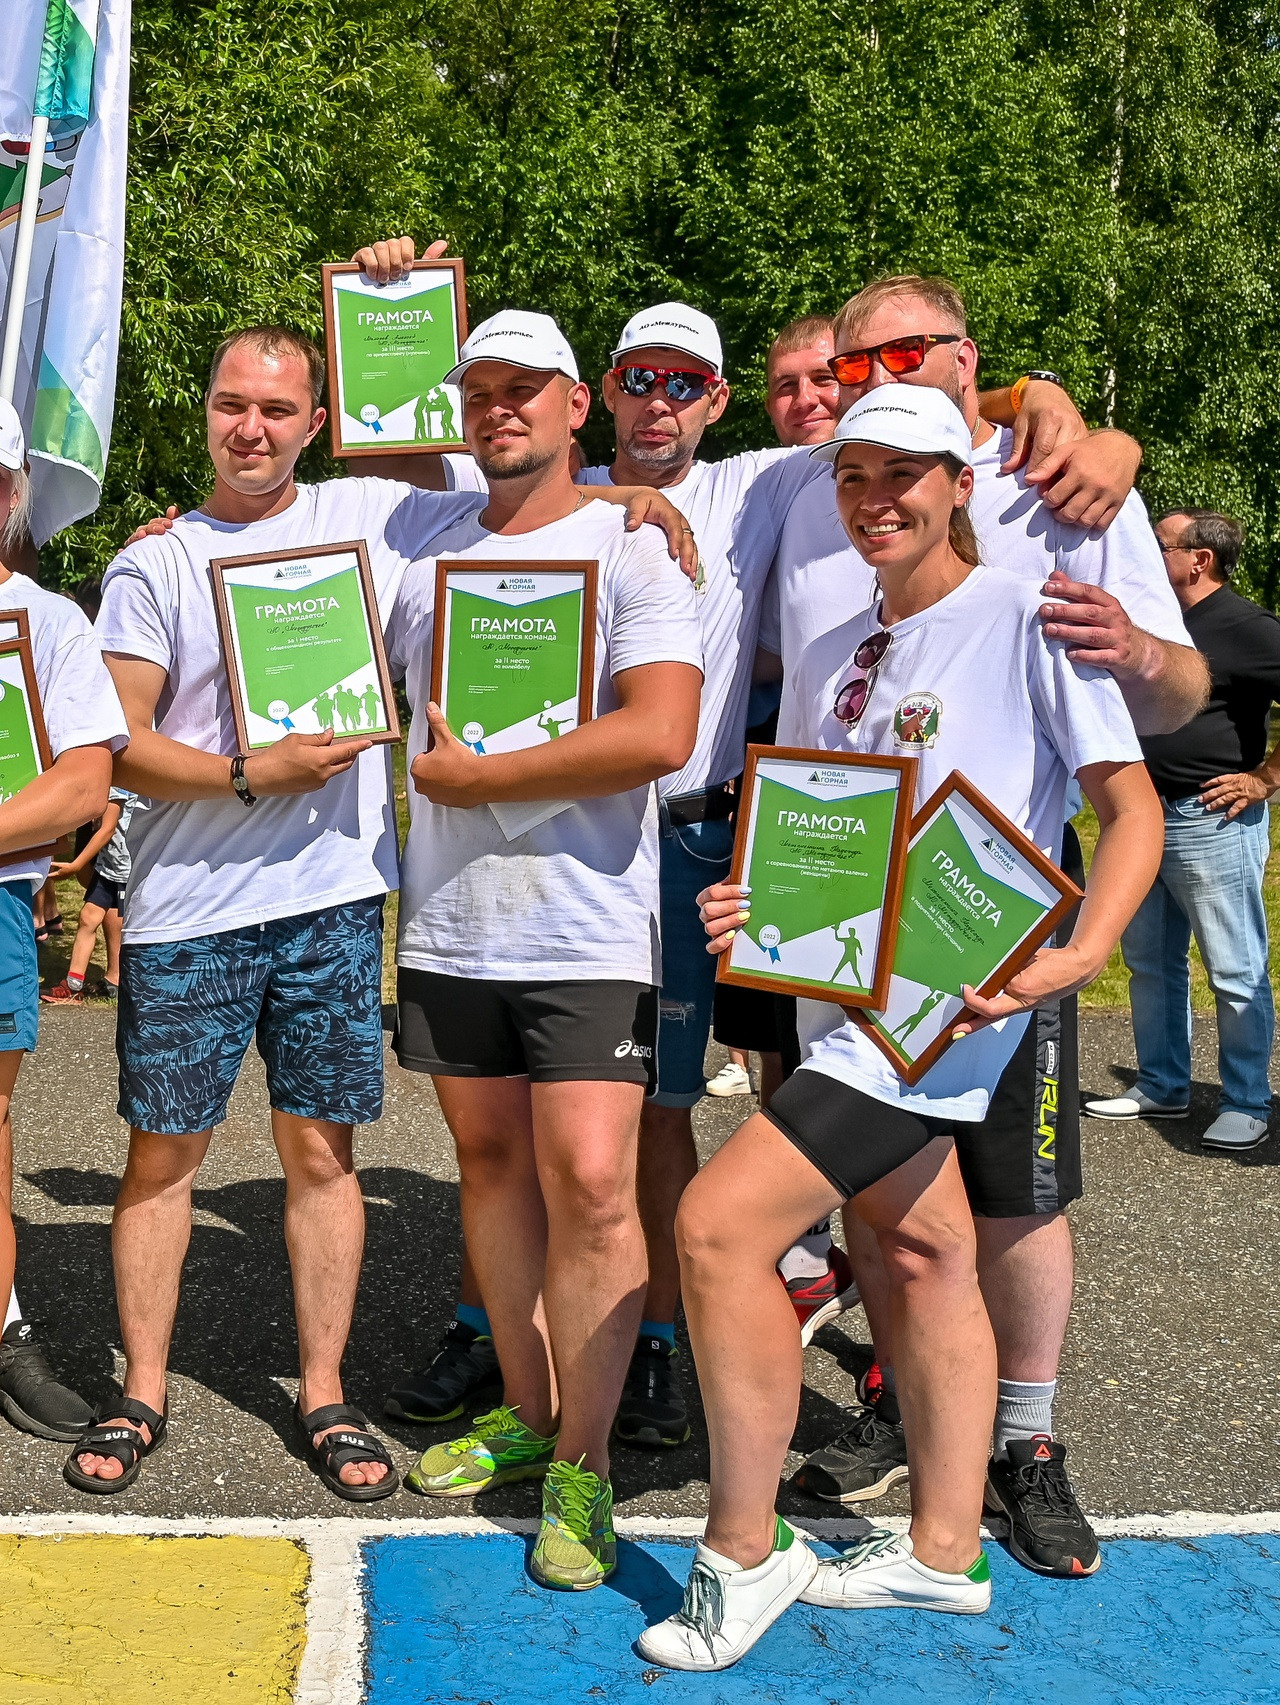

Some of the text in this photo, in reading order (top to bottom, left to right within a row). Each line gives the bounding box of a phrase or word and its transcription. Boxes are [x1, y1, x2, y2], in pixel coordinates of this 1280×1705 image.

[358, 310, 434, 326] ГРАМОТА
[255, 596, 340, 620] ГРАМОТА
[274, 612, 325, 624] награждается
[471, 618, 557, 633] ГРАМОТА
[778, 810, 866, 834] ГРАМОТА
[794, 830, 848, 840] награждается
[990, 848, 1014, 872] ГОРНАЯ
[996, 842, 1016, 864] НОВАЯ
[932, 850, 1002, 928] ГРАМОТА
[938, 876, 980, 920] награждается
[928, 906, 936, 914] за
[938, 914, 954, 933] место
[632, 1044, 652, 1058] asics
[1038, 1076, 1058, 1160] RUN
[105, 1430, 129, 1440] SUS
[340, 1434, 364, 1446] SUS
